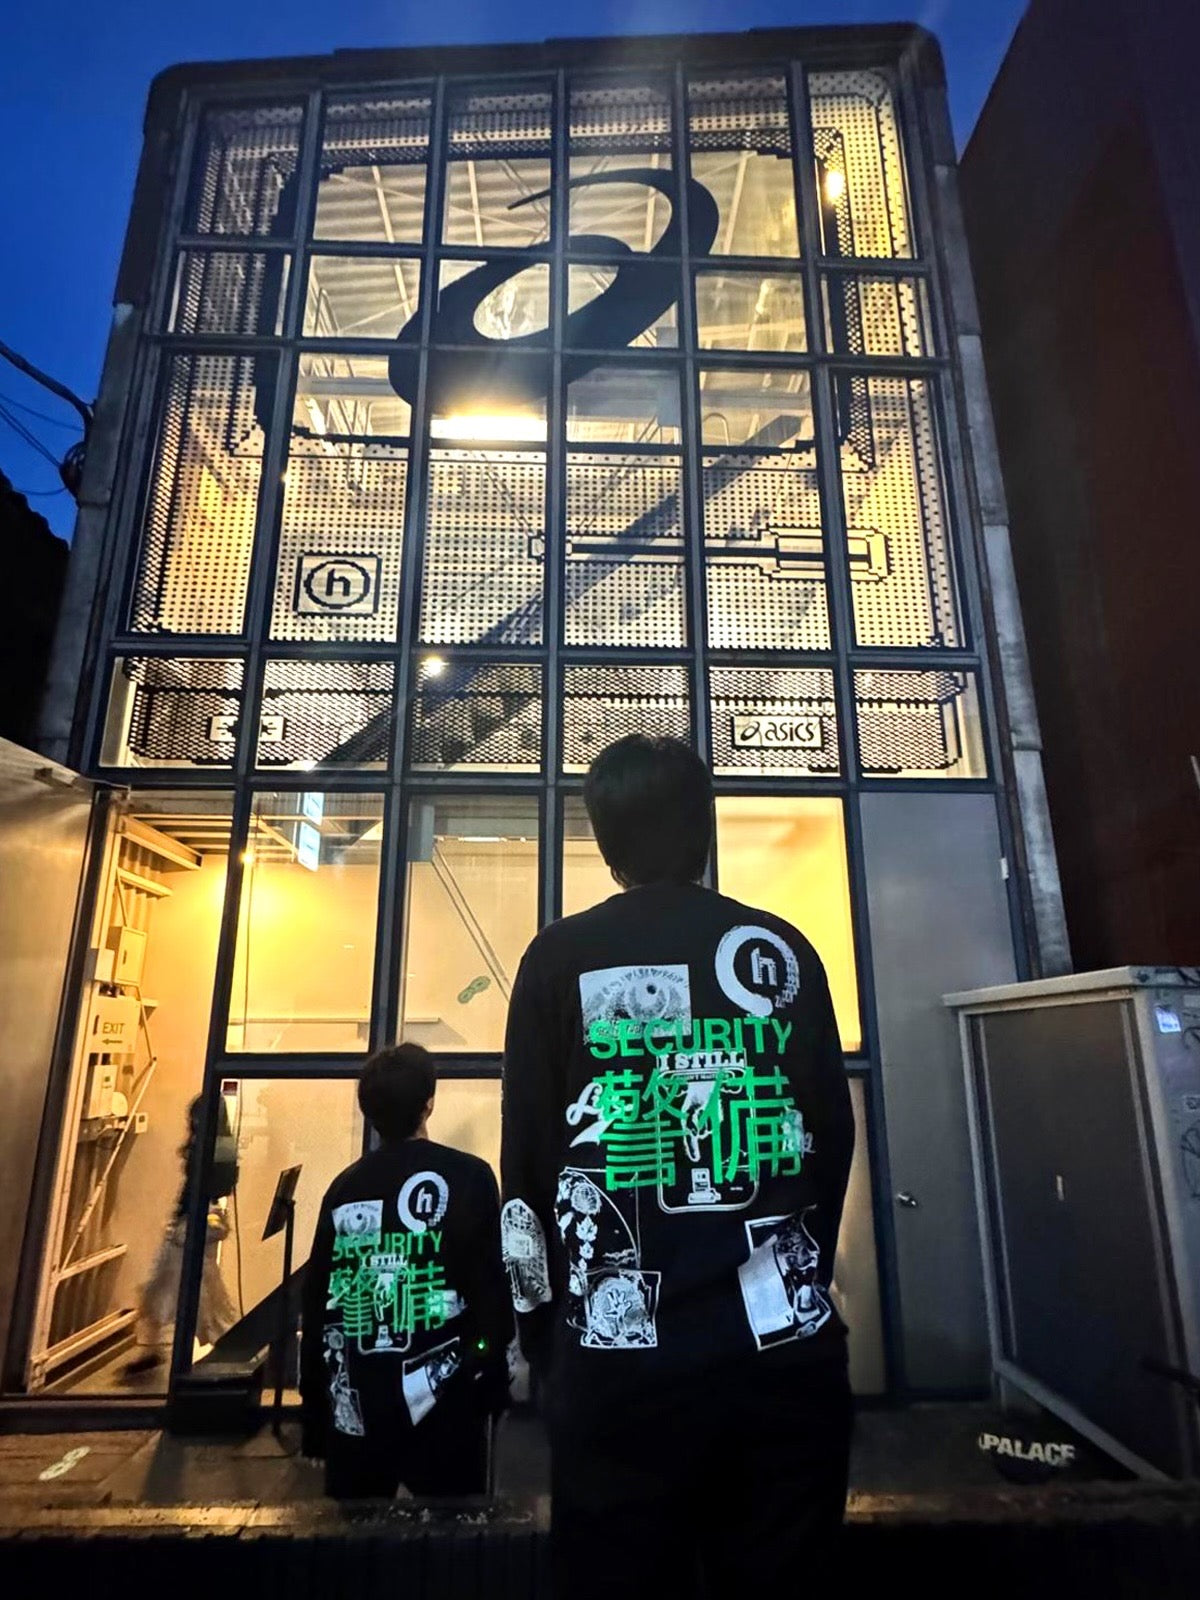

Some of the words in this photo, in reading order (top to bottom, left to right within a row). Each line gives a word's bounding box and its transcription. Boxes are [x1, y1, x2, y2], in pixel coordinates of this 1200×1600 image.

[325, 568, 351, 597] h
[764, 721, 815, 742] asics
[750, 947, 778, 987] h
[102, 1022, 125, 1035] EXIT
[589, 1016, 793, 1060] SECURITY
[674, 1050, 745, 1070] STILL
[592, 1066, 802, 1191] 警備
[331, 1230, 443, 1262] SECURITY
